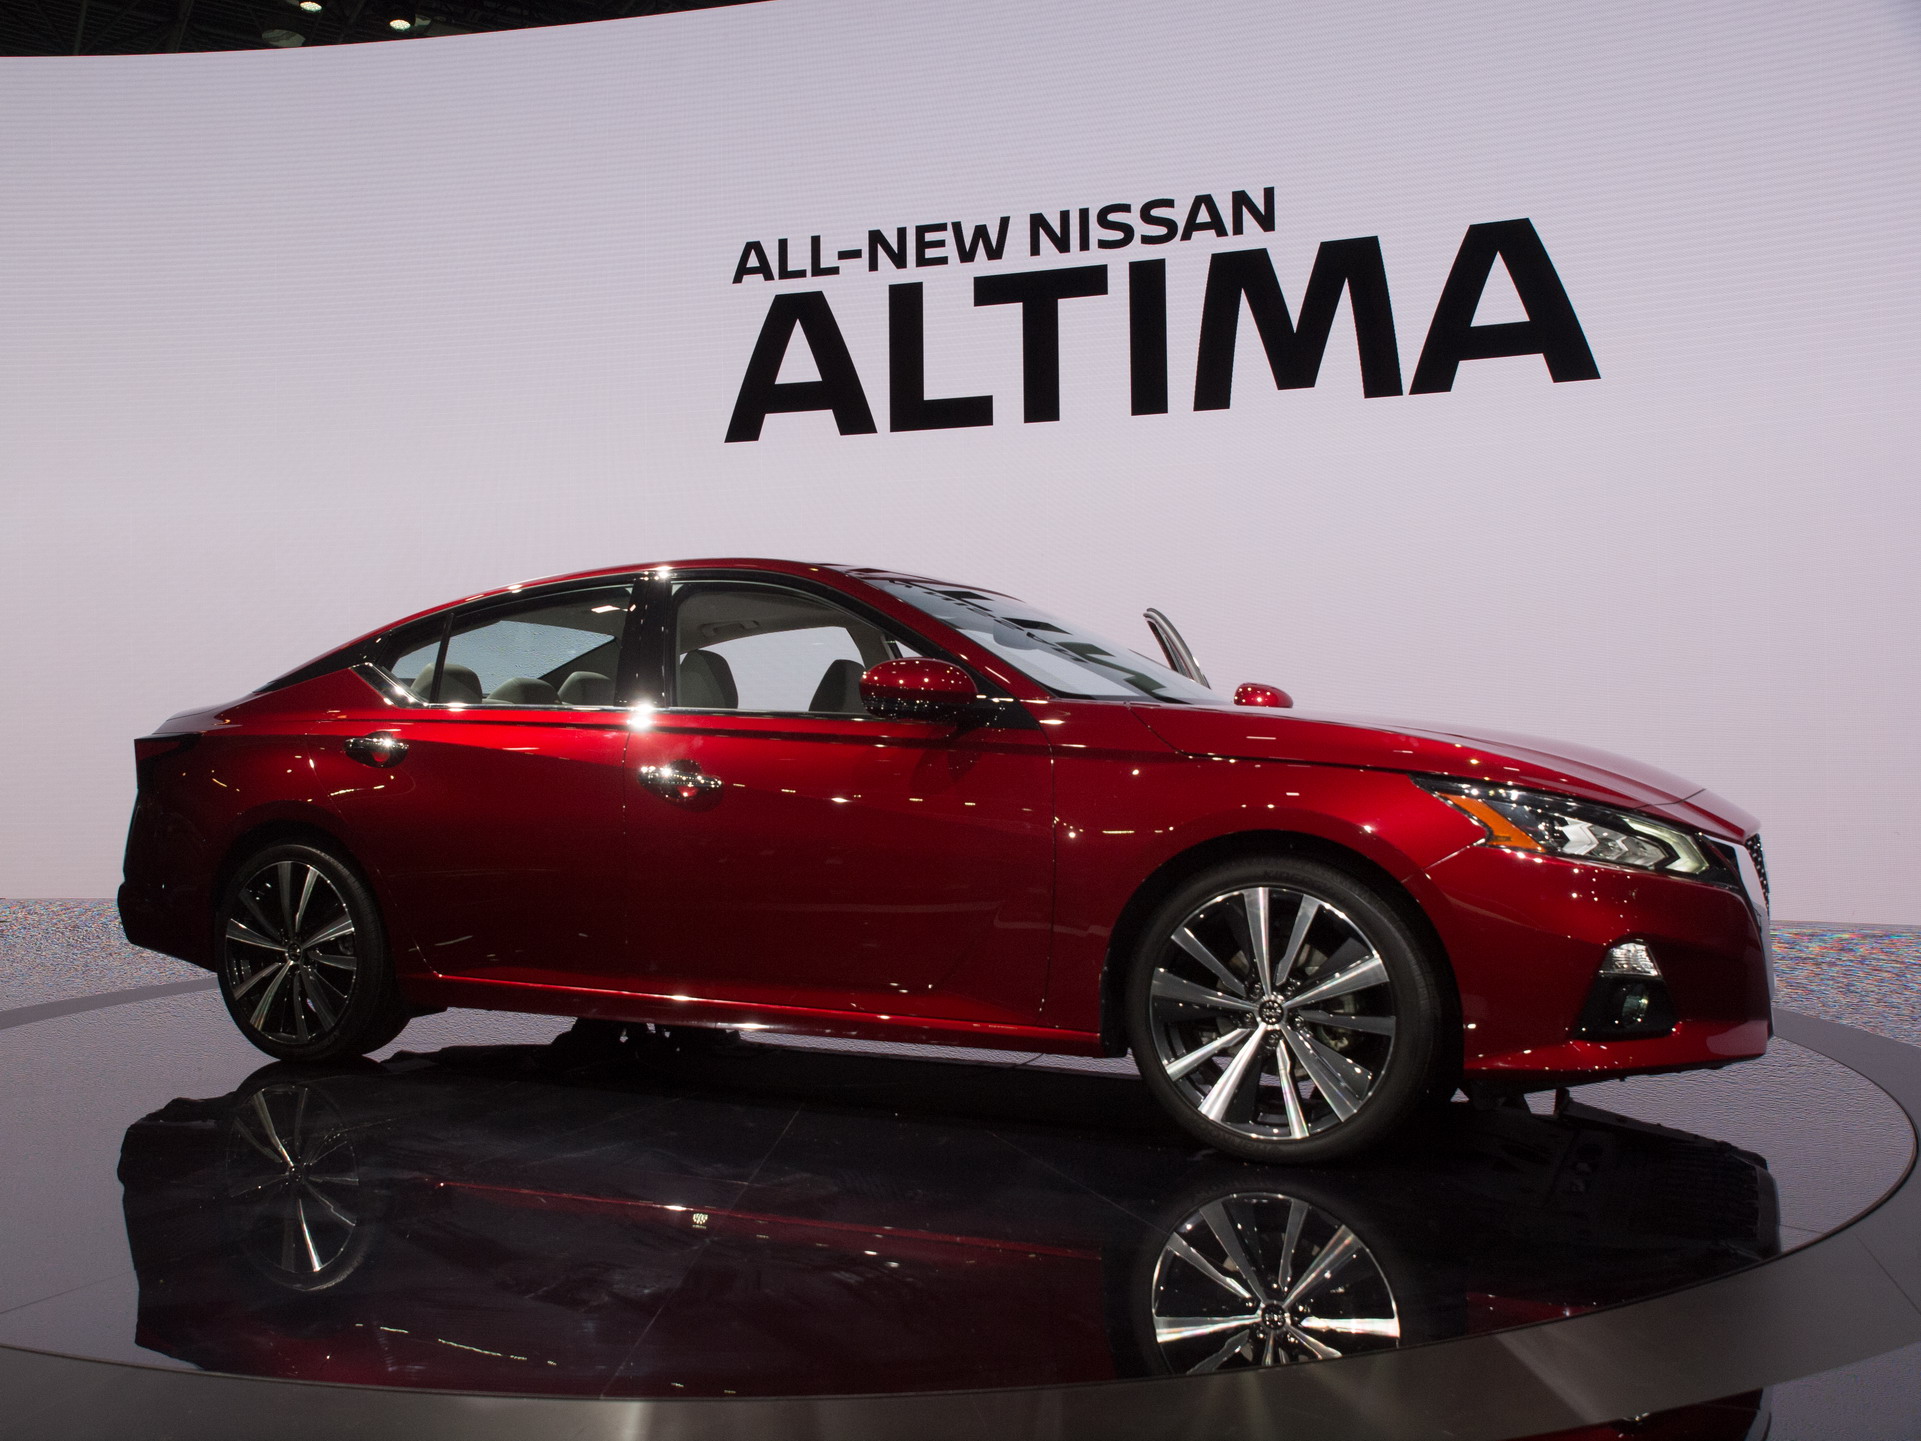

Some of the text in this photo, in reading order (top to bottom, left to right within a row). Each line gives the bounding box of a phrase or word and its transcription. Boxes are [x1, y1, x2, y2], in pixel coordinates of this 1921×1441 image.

[733, 187, 1276, 284] ALL-NEW NISSAN
[725, 218, 1602, 443] ALTIMA
